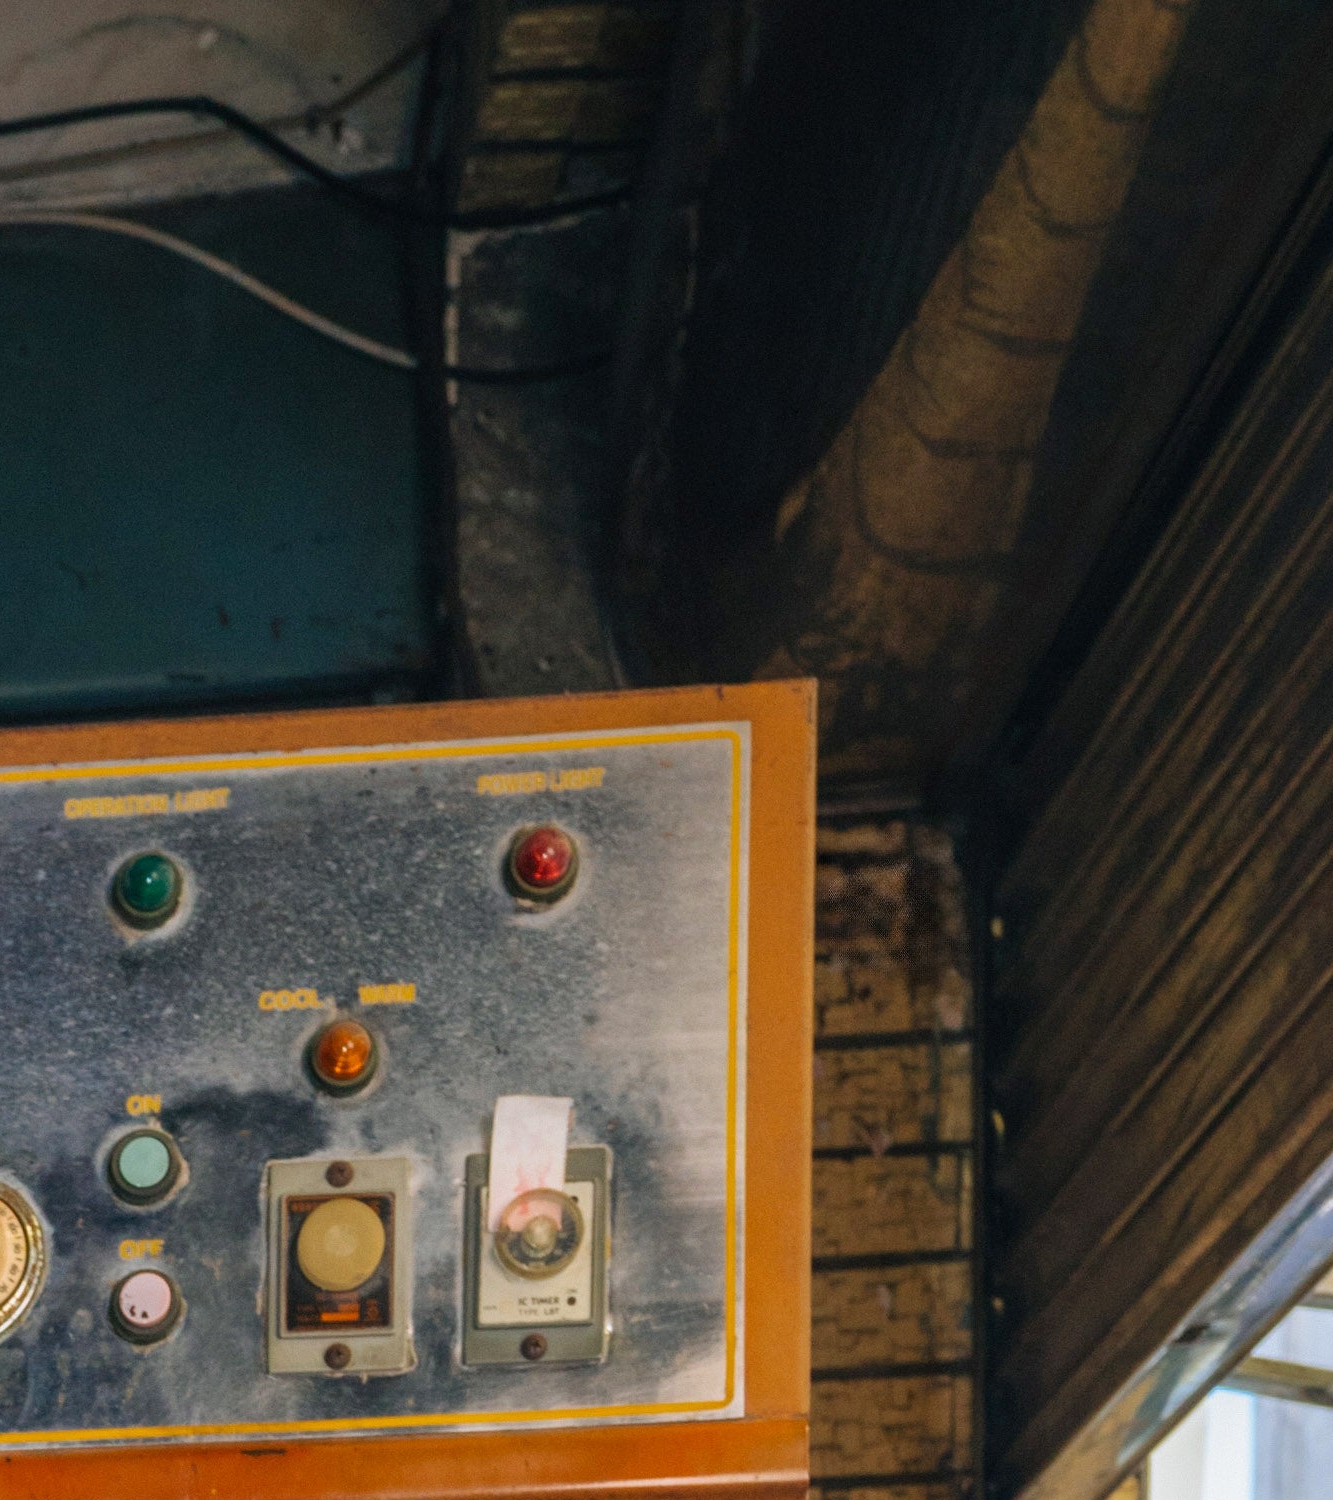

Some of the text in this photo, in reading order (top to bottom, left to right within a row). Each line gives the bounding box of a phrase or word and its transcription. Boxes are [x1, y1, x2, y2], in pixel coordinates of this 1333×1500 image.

[477, 766, 606, 796] POWER LIGHT
[64, 787, 231, 820] OPERATION LIGHT
[258, 983, 417, 1012] COOL WARM
[126, 1094, 162, 1116] ON
[118, 1238, 165, 1260] OFF
[531, 1296, 560, 1305] TIMER
